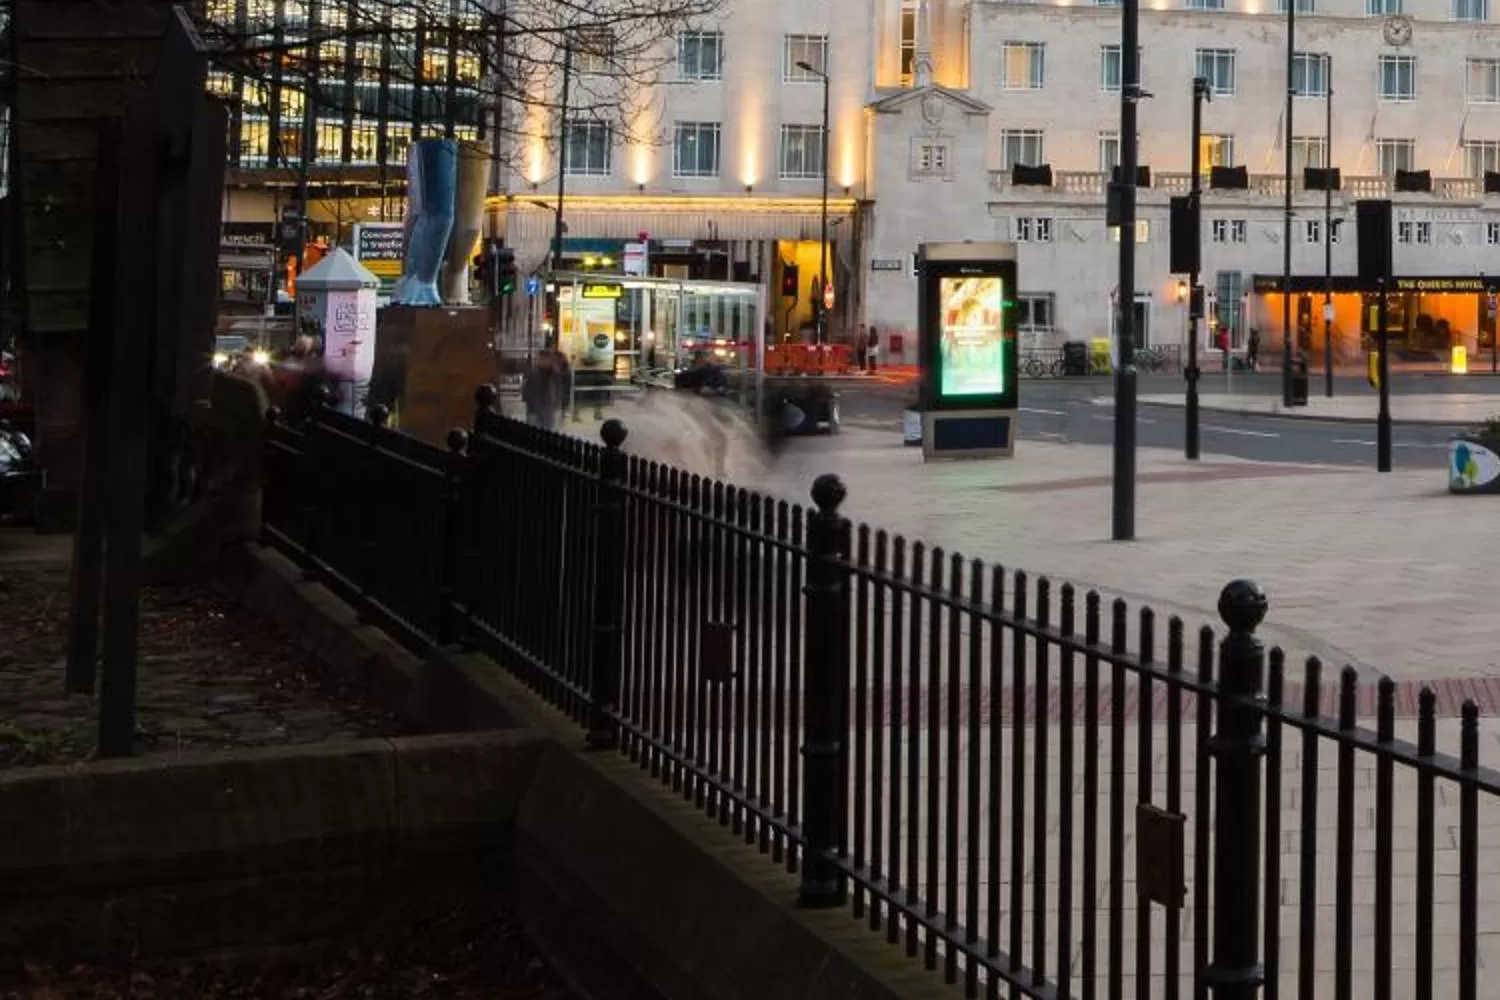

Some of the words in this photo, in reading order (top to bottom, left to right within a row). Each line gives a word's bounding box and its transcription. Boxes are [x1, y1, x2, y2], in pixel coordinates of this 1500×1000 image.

[1397, 280, 1415, 289] THE
[1417, 280, 1455, 290] QUEENS
[1456, 280, 1485, 289] HOTEL
